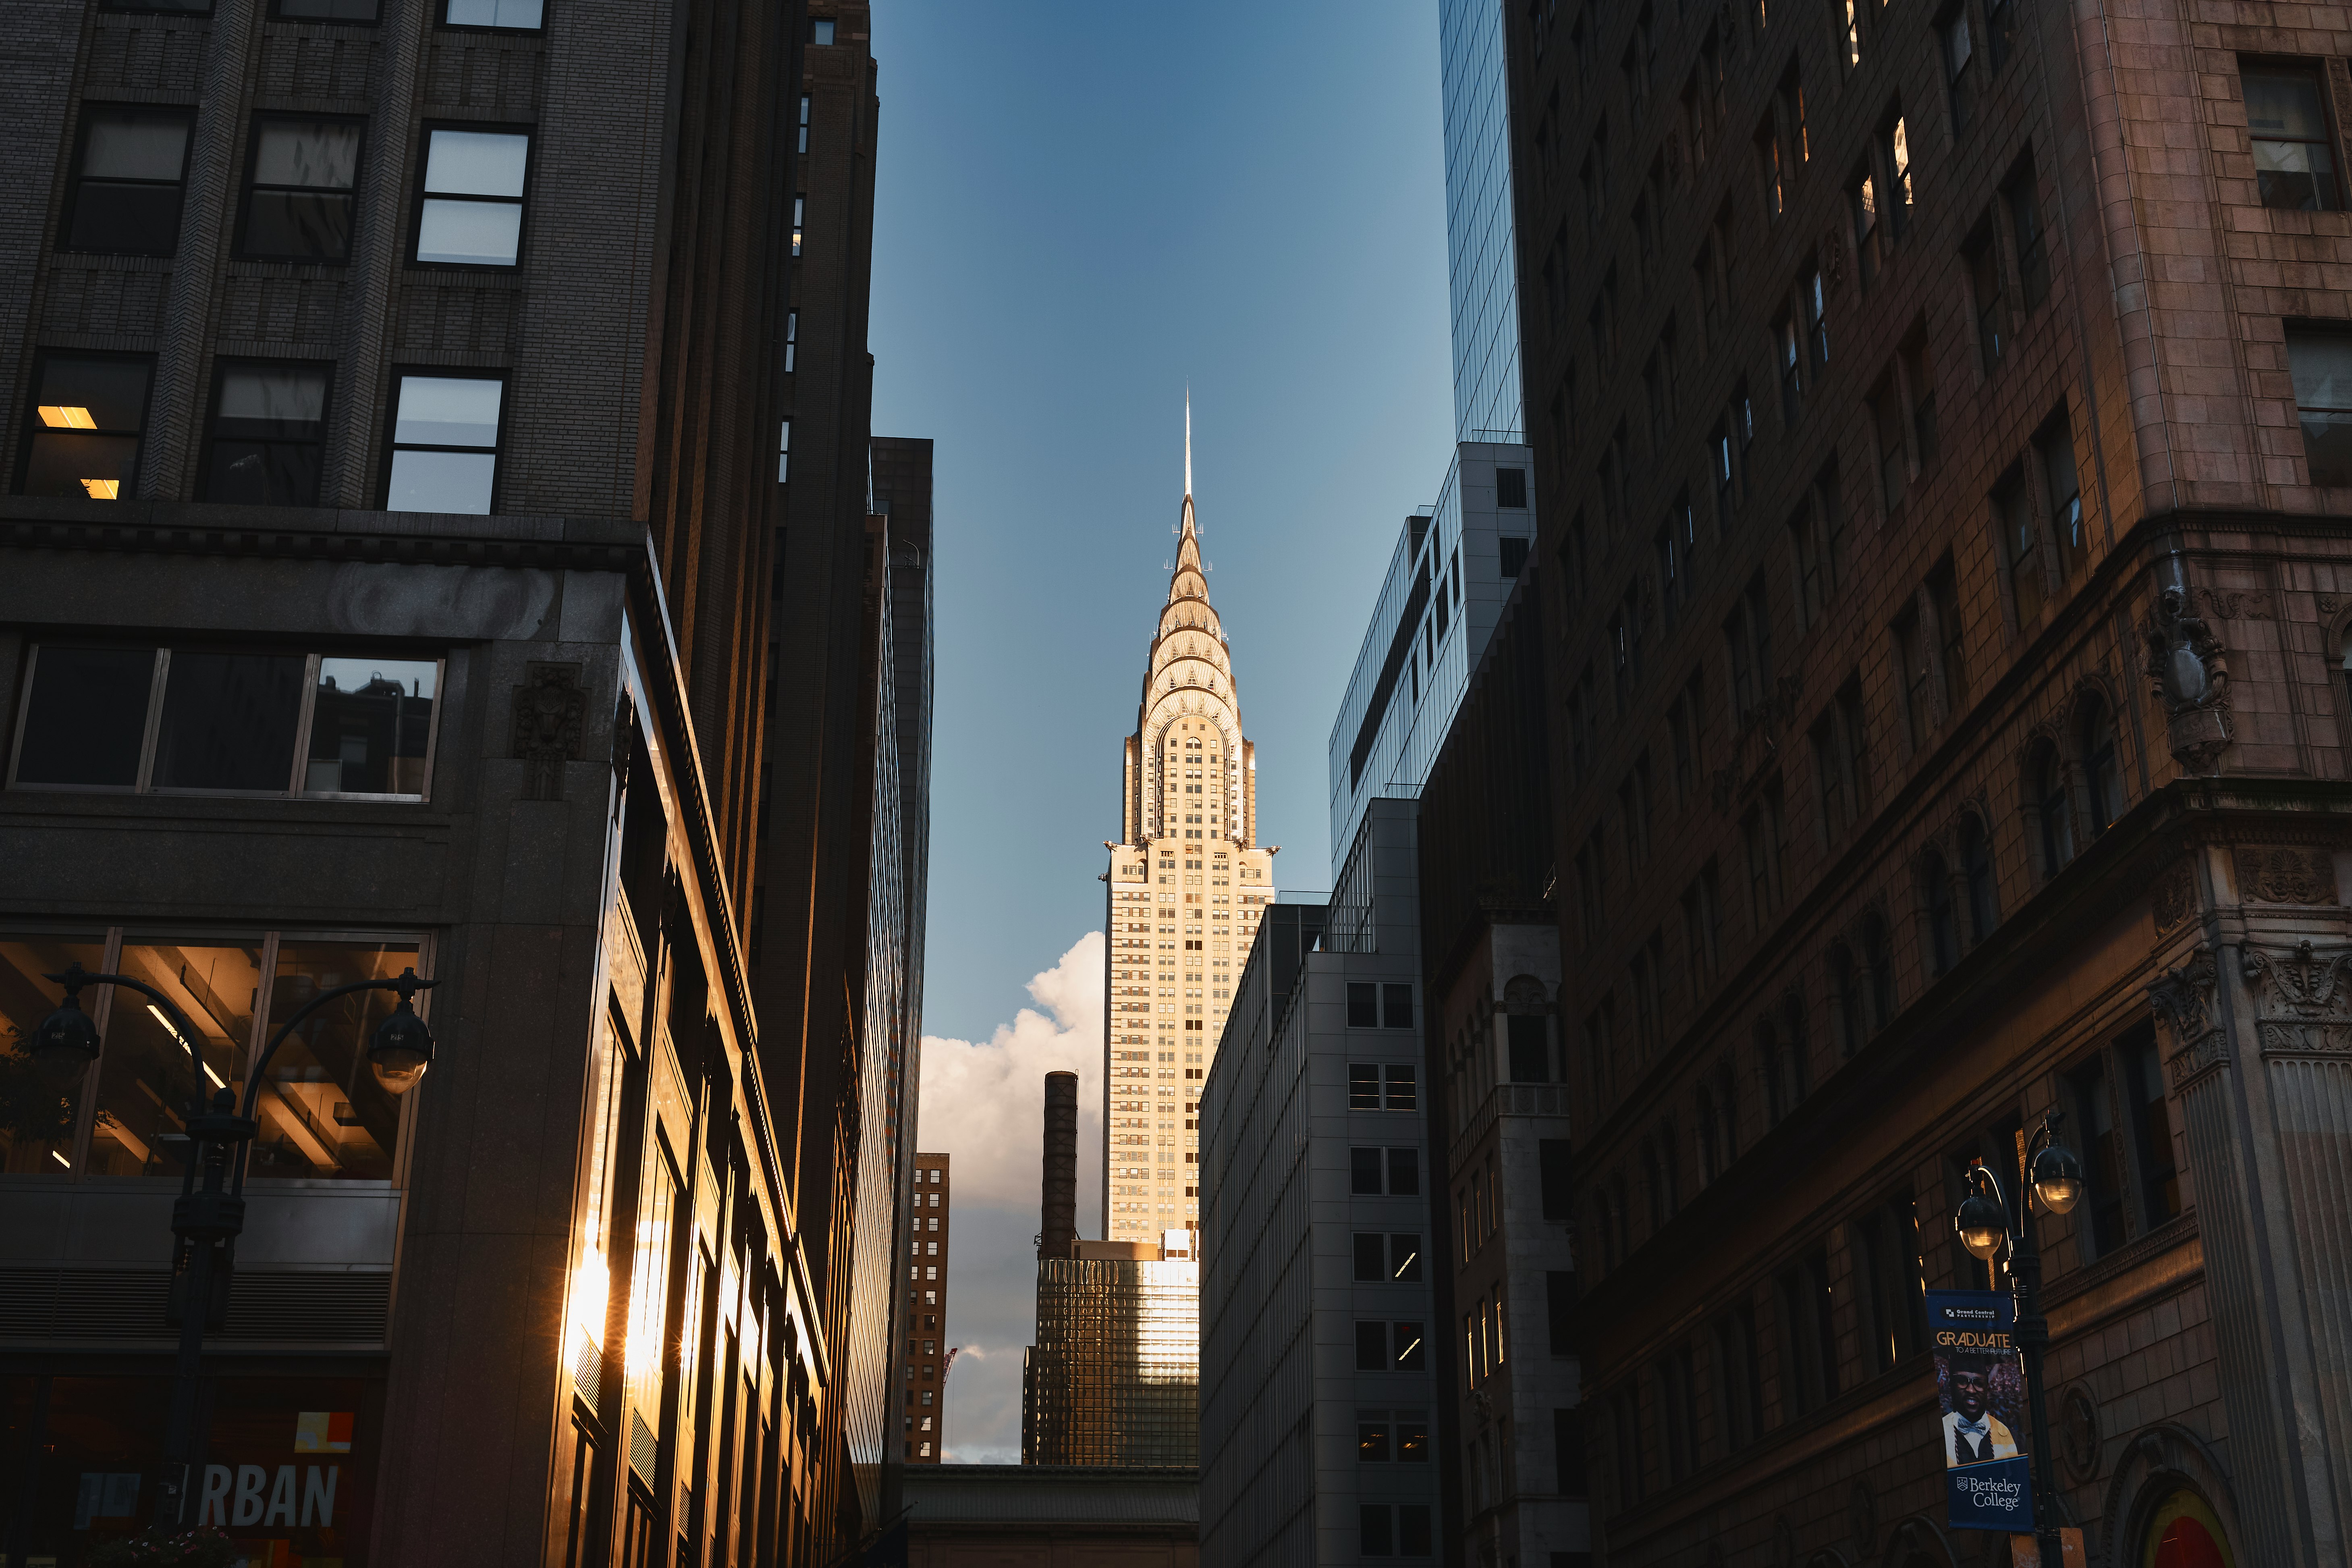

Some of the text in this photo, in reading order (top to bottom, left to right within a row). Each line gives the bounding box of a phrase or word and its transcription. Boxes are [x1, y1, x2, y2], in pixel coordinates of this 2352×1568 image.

[1936, 1331, 2011, 1348] GRADUATE
[177, 1464, 339, 1527] RBAN
[1969, 1477, 2021, 1497] Berkeley
